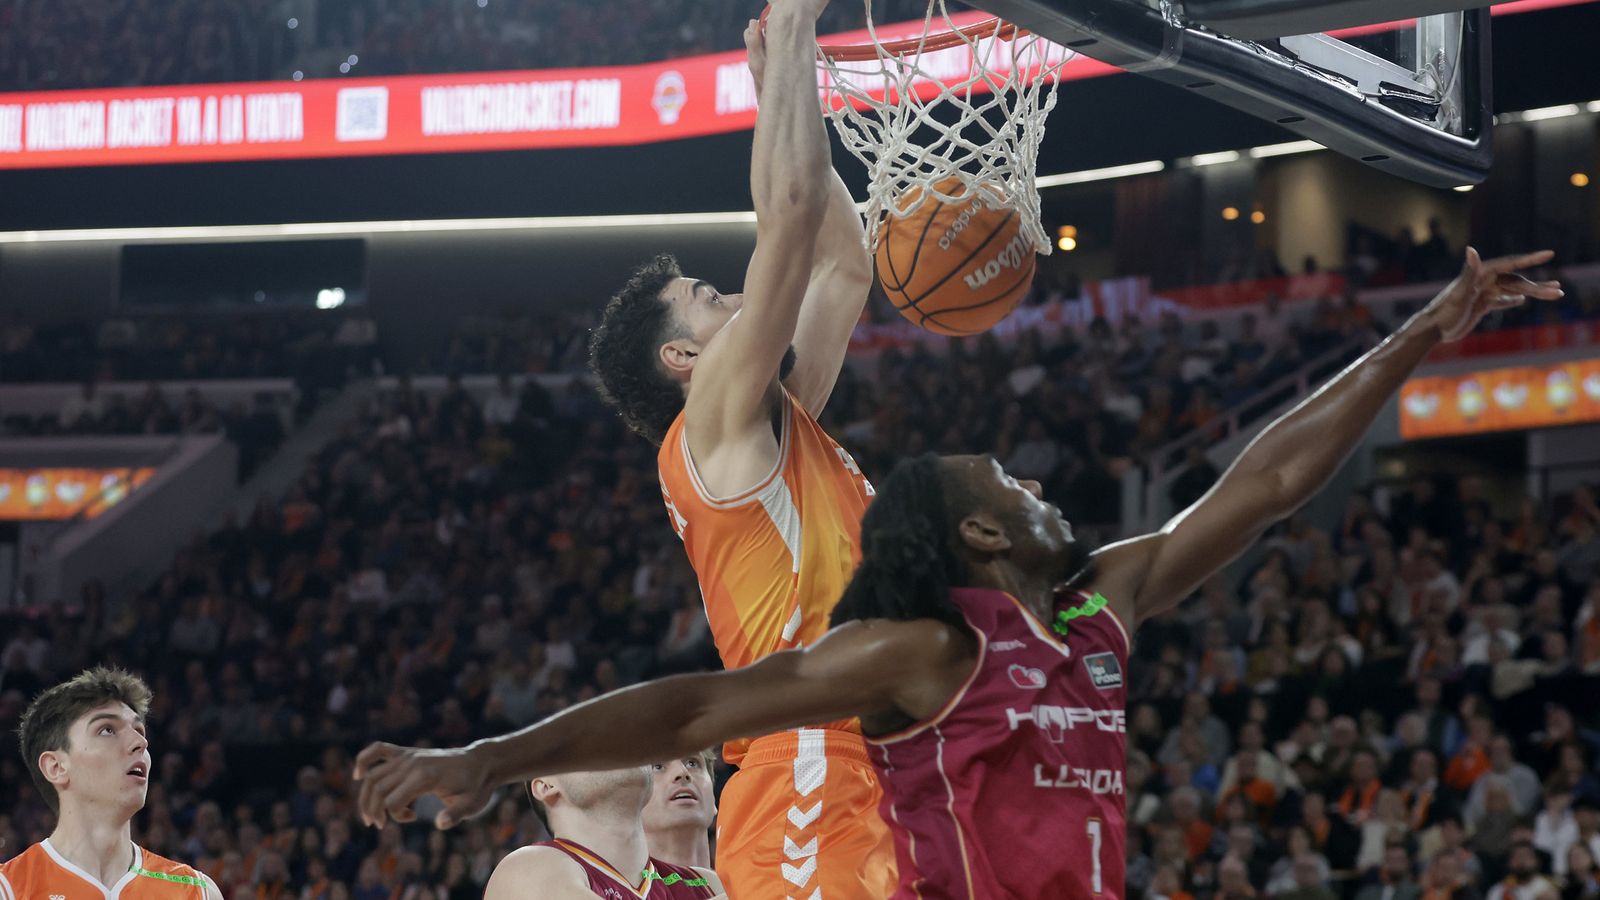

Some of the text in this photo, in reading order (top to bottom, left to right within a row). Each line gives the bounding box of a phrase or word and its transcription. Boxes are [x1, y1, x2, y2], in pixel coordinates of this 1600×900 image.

[177, 97, 201, 144] YA
[202, 96, 218, 143] A
[220, 95, 243, 143] LA
[245, 93, 303, 142] VENTA
[1086, 817, 1103, 896] 1
